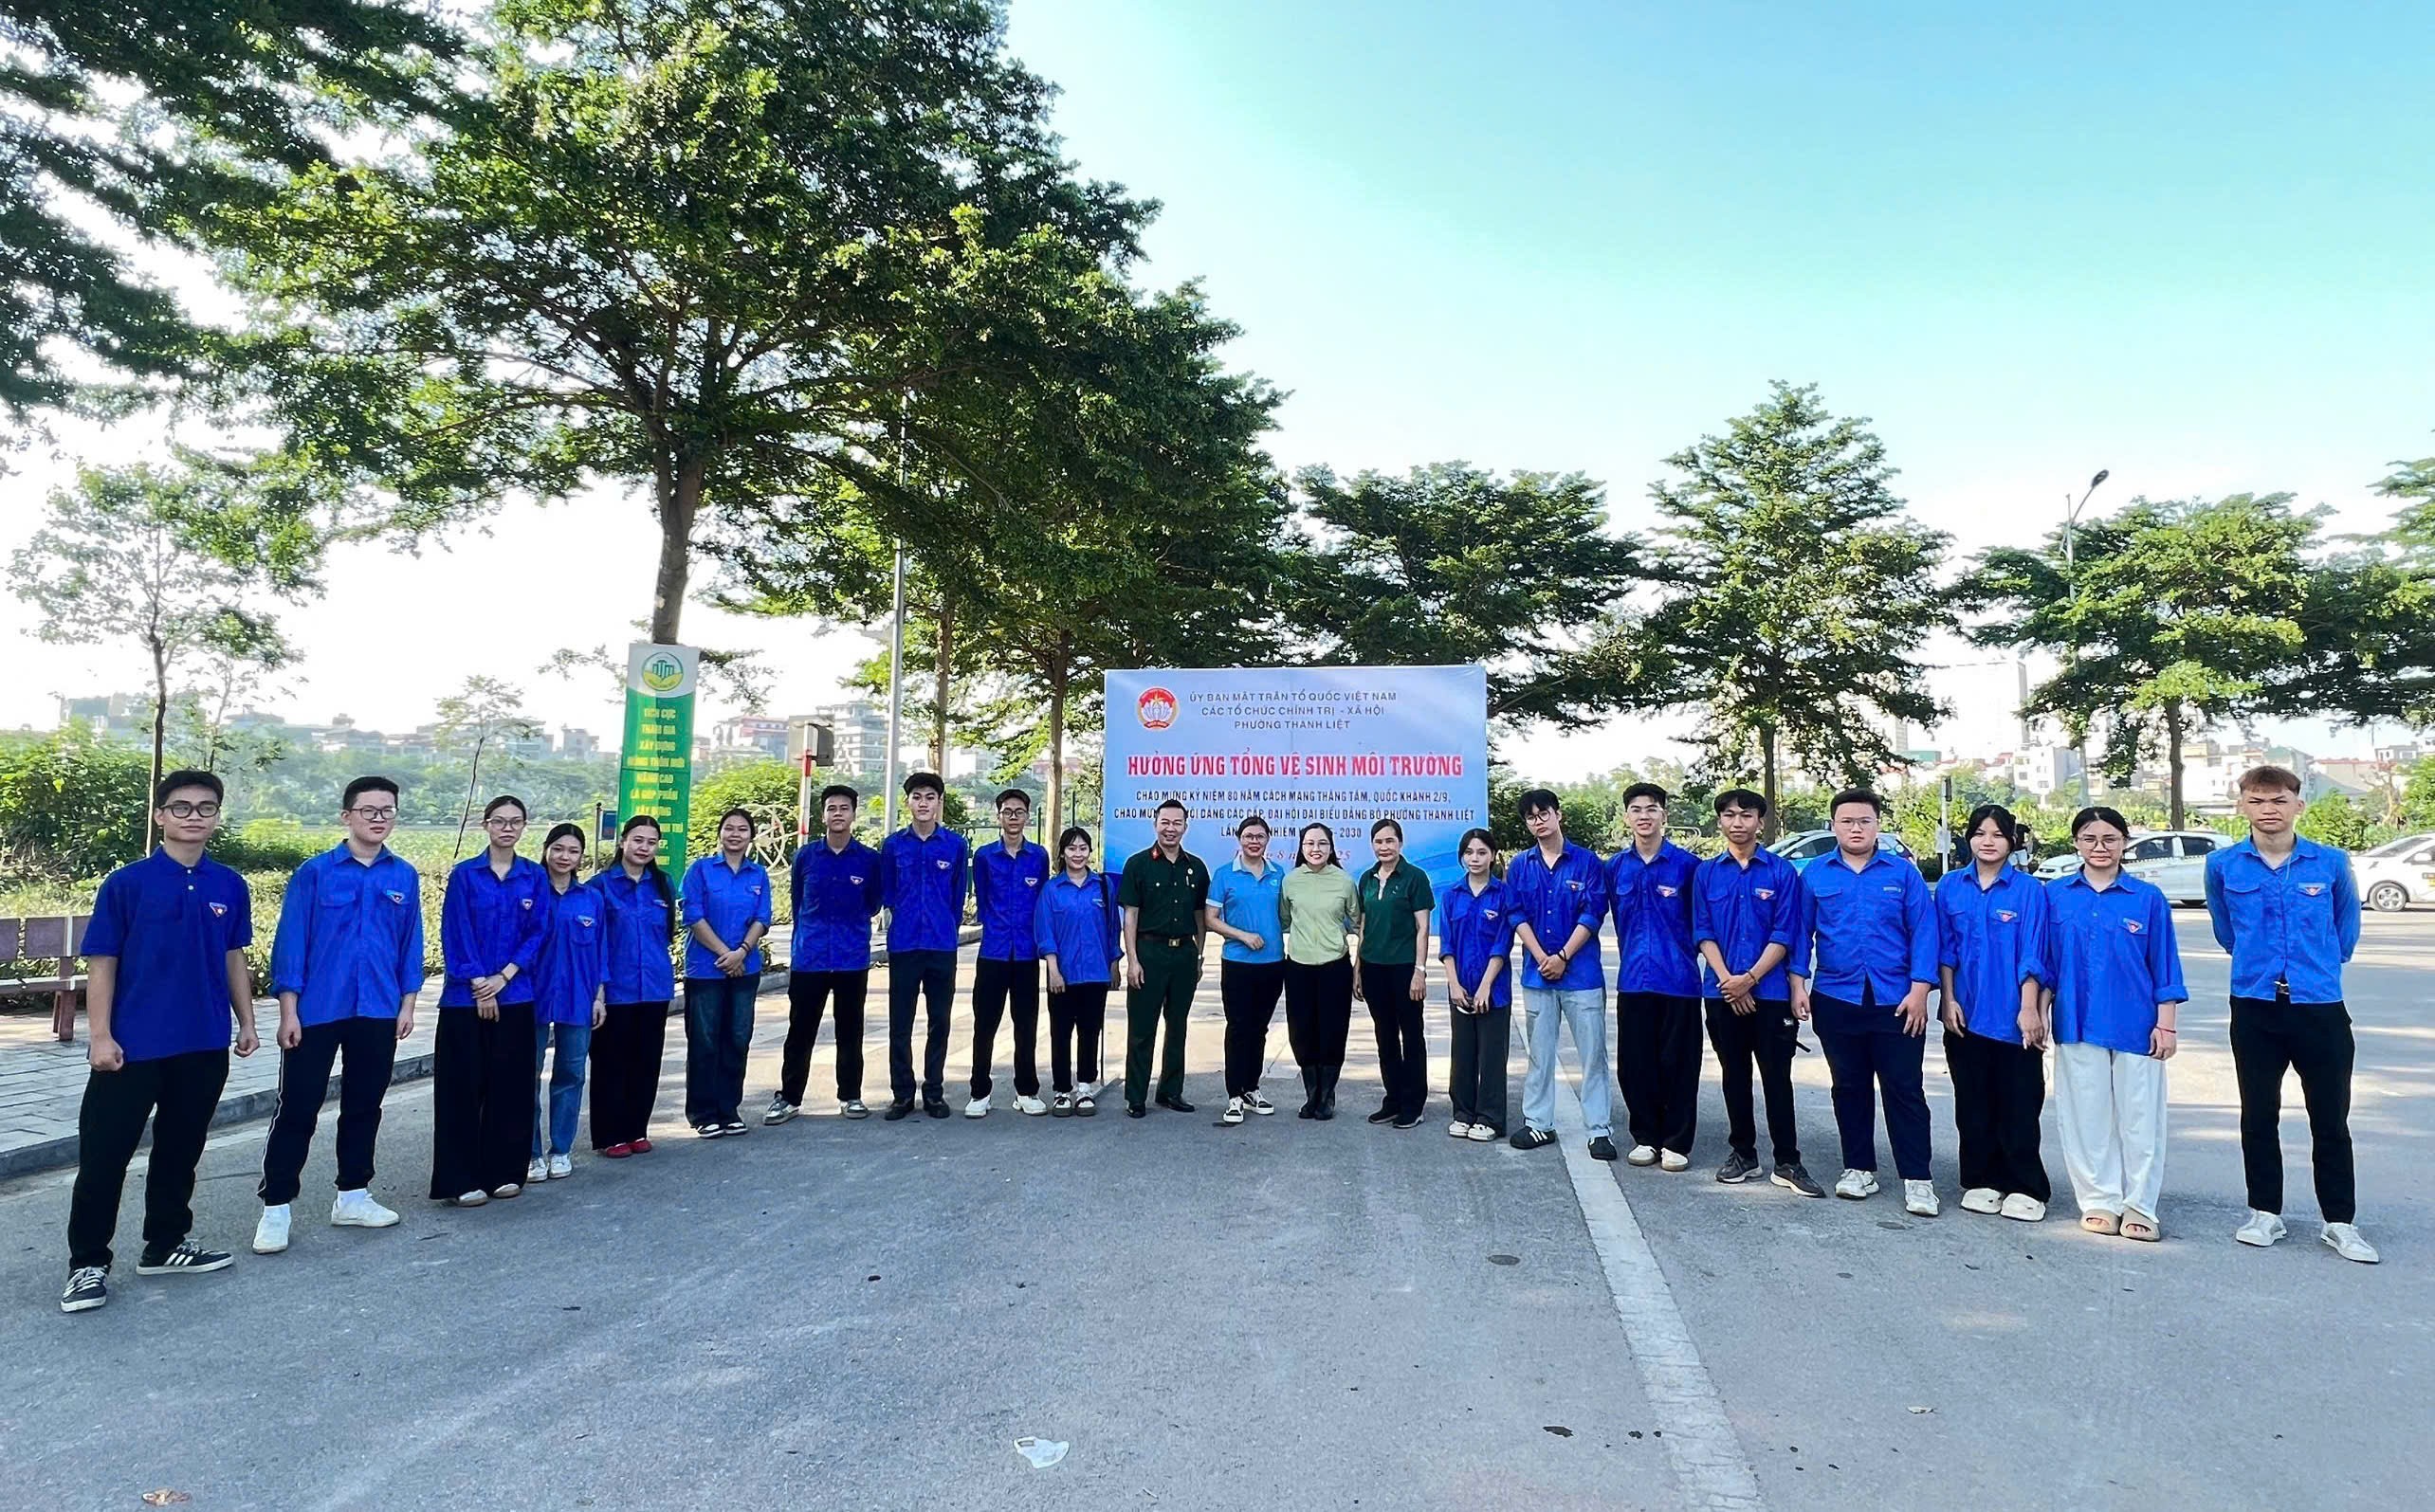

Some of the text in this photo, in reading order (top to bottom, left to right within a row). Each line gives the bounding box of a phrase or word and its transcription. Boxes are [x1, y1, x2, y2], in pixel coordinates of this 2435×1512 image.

[1190, 691, 1203, 702] ỦY
[1207, 693, 1230, 701] BAN
[1291, 688, 1306, 701] TỔ
[1309, 690, 1341, 701] QUỐC
[1344, 691, 1368, 702] VIỆT
[1372, 692, 1396, 701] NAM
[1201, 705, 1224, 716] CÁC
[1227, 703, 1241, 716] TỔ
[1244, 704, 1275, 716] CHỨC
[1279, 705, 1313, 715] CHÍNH
[1317, 706, 1335, 717] TRỊ
[1347, 705, 1362, 715] XÃ
[1365, 705, 1384, 717] HỘI
[1235, 720, 1350, 730] PHƯỜNG THANH LIỆT
[1127, 747, 1462, 779] HƯỞNG ỨNG TỔNG VỆ SINH MÔI TRƯỜNG
[1136, 790, 1160, 801] CHÀO
[1202, 790, 1225, 803] NIỆM
[1228, 791, 1238, 801] 80
[1240, 789, 1260, 801] NĂM
[1263, 789, 1287, 801] CÁCH
[1289, 791, 1315, 804] MẠNG
[1317, 789, 1346, 801] THÁNG
[1373, 788, 1398, 802] QUỐC
[1400, 789, 1431, 802] KHÁNH
[1227, 806, 1244, 819] CÁC
[1285, 807, 1300, 821] HỘI
[1320, 804, 1340, 819] BIỂU
[1343, 805, 1367, 819] ĐẢNG
[1384, 808, 1420, 820] PHƯỜNG
[1423, 810, 1453, 820] THANH
[1456, 808, 1474, 823] LIỆT
[1340, 827, 1362, 838] 2030
